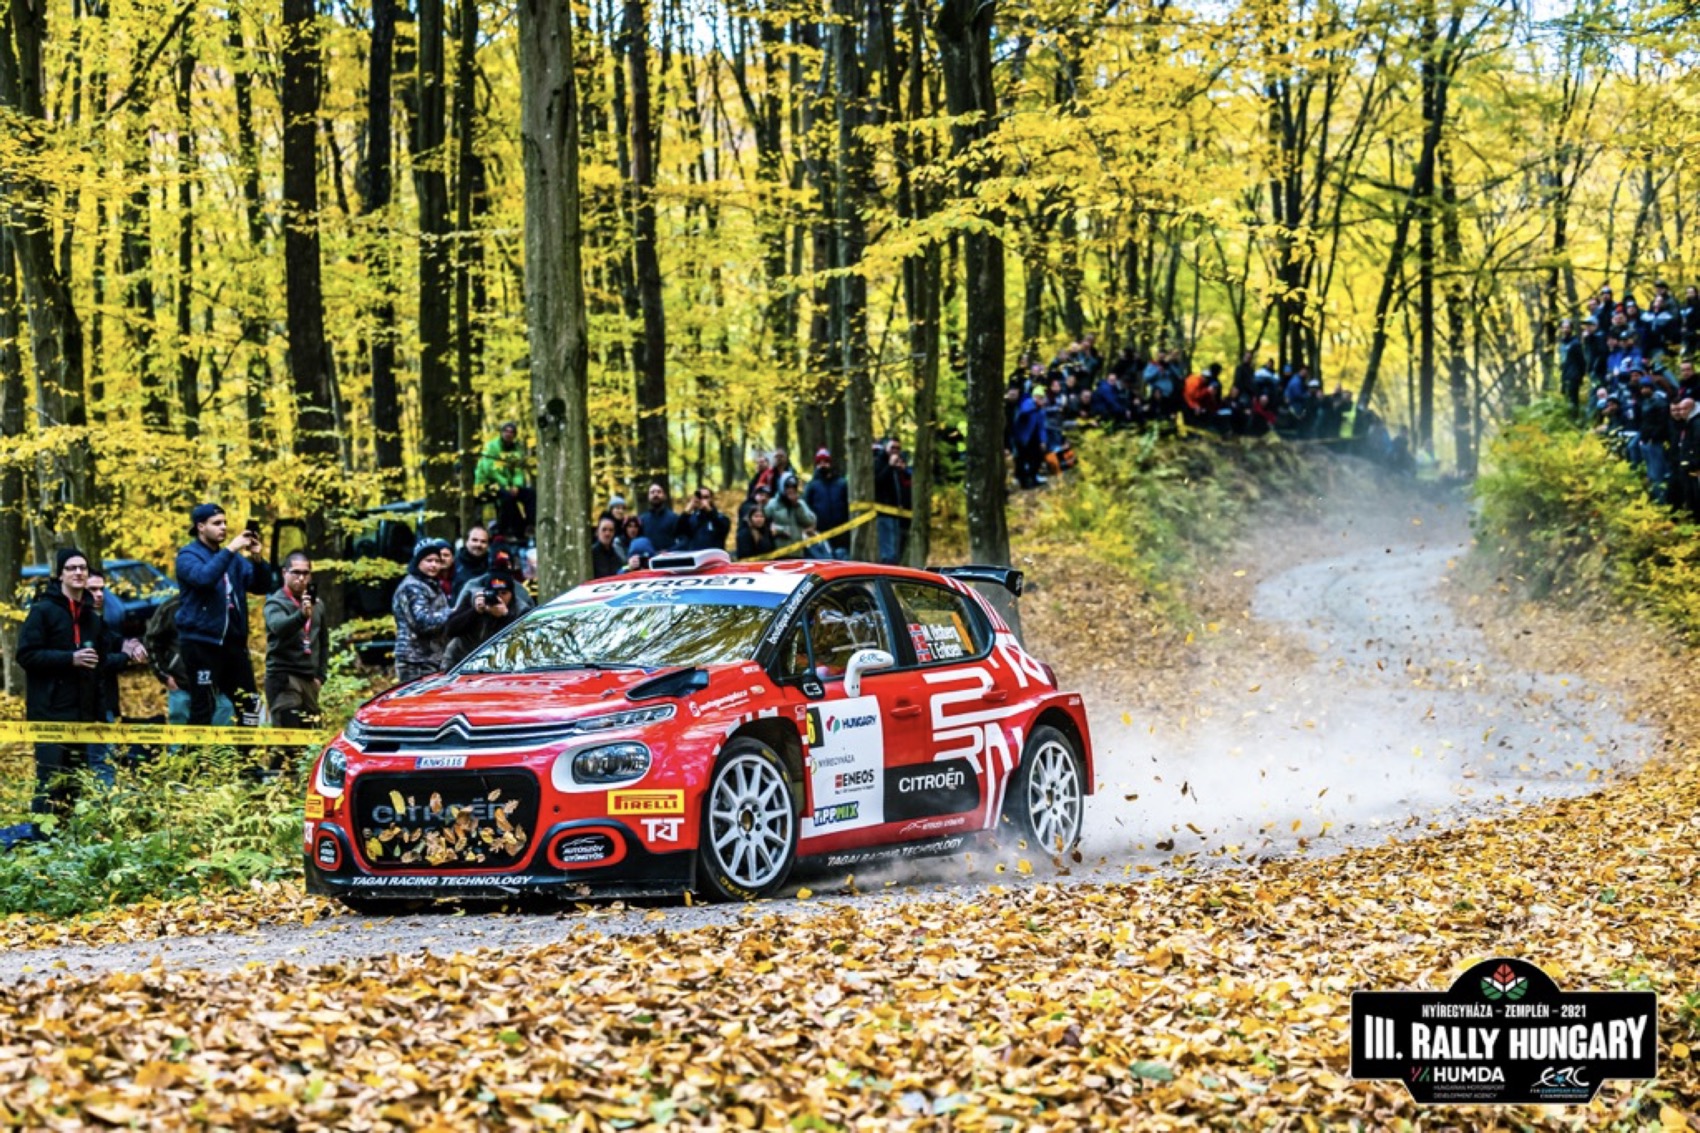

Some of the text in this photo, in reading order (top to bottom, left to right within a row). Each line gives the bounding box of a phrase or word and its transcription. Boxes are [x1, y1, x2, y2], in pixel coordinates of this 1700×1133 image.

[197, 670, 211, 681] 27
[803, 682, 823, 697] C3
[842, 715, 877, 729] HUNGARY
[843, 769, 875, 787] ENEOS
[614, 794, 678, 811] PIRELLI
[351, 875, 533, 886] TAGAI RACING TECHNOLOGY
